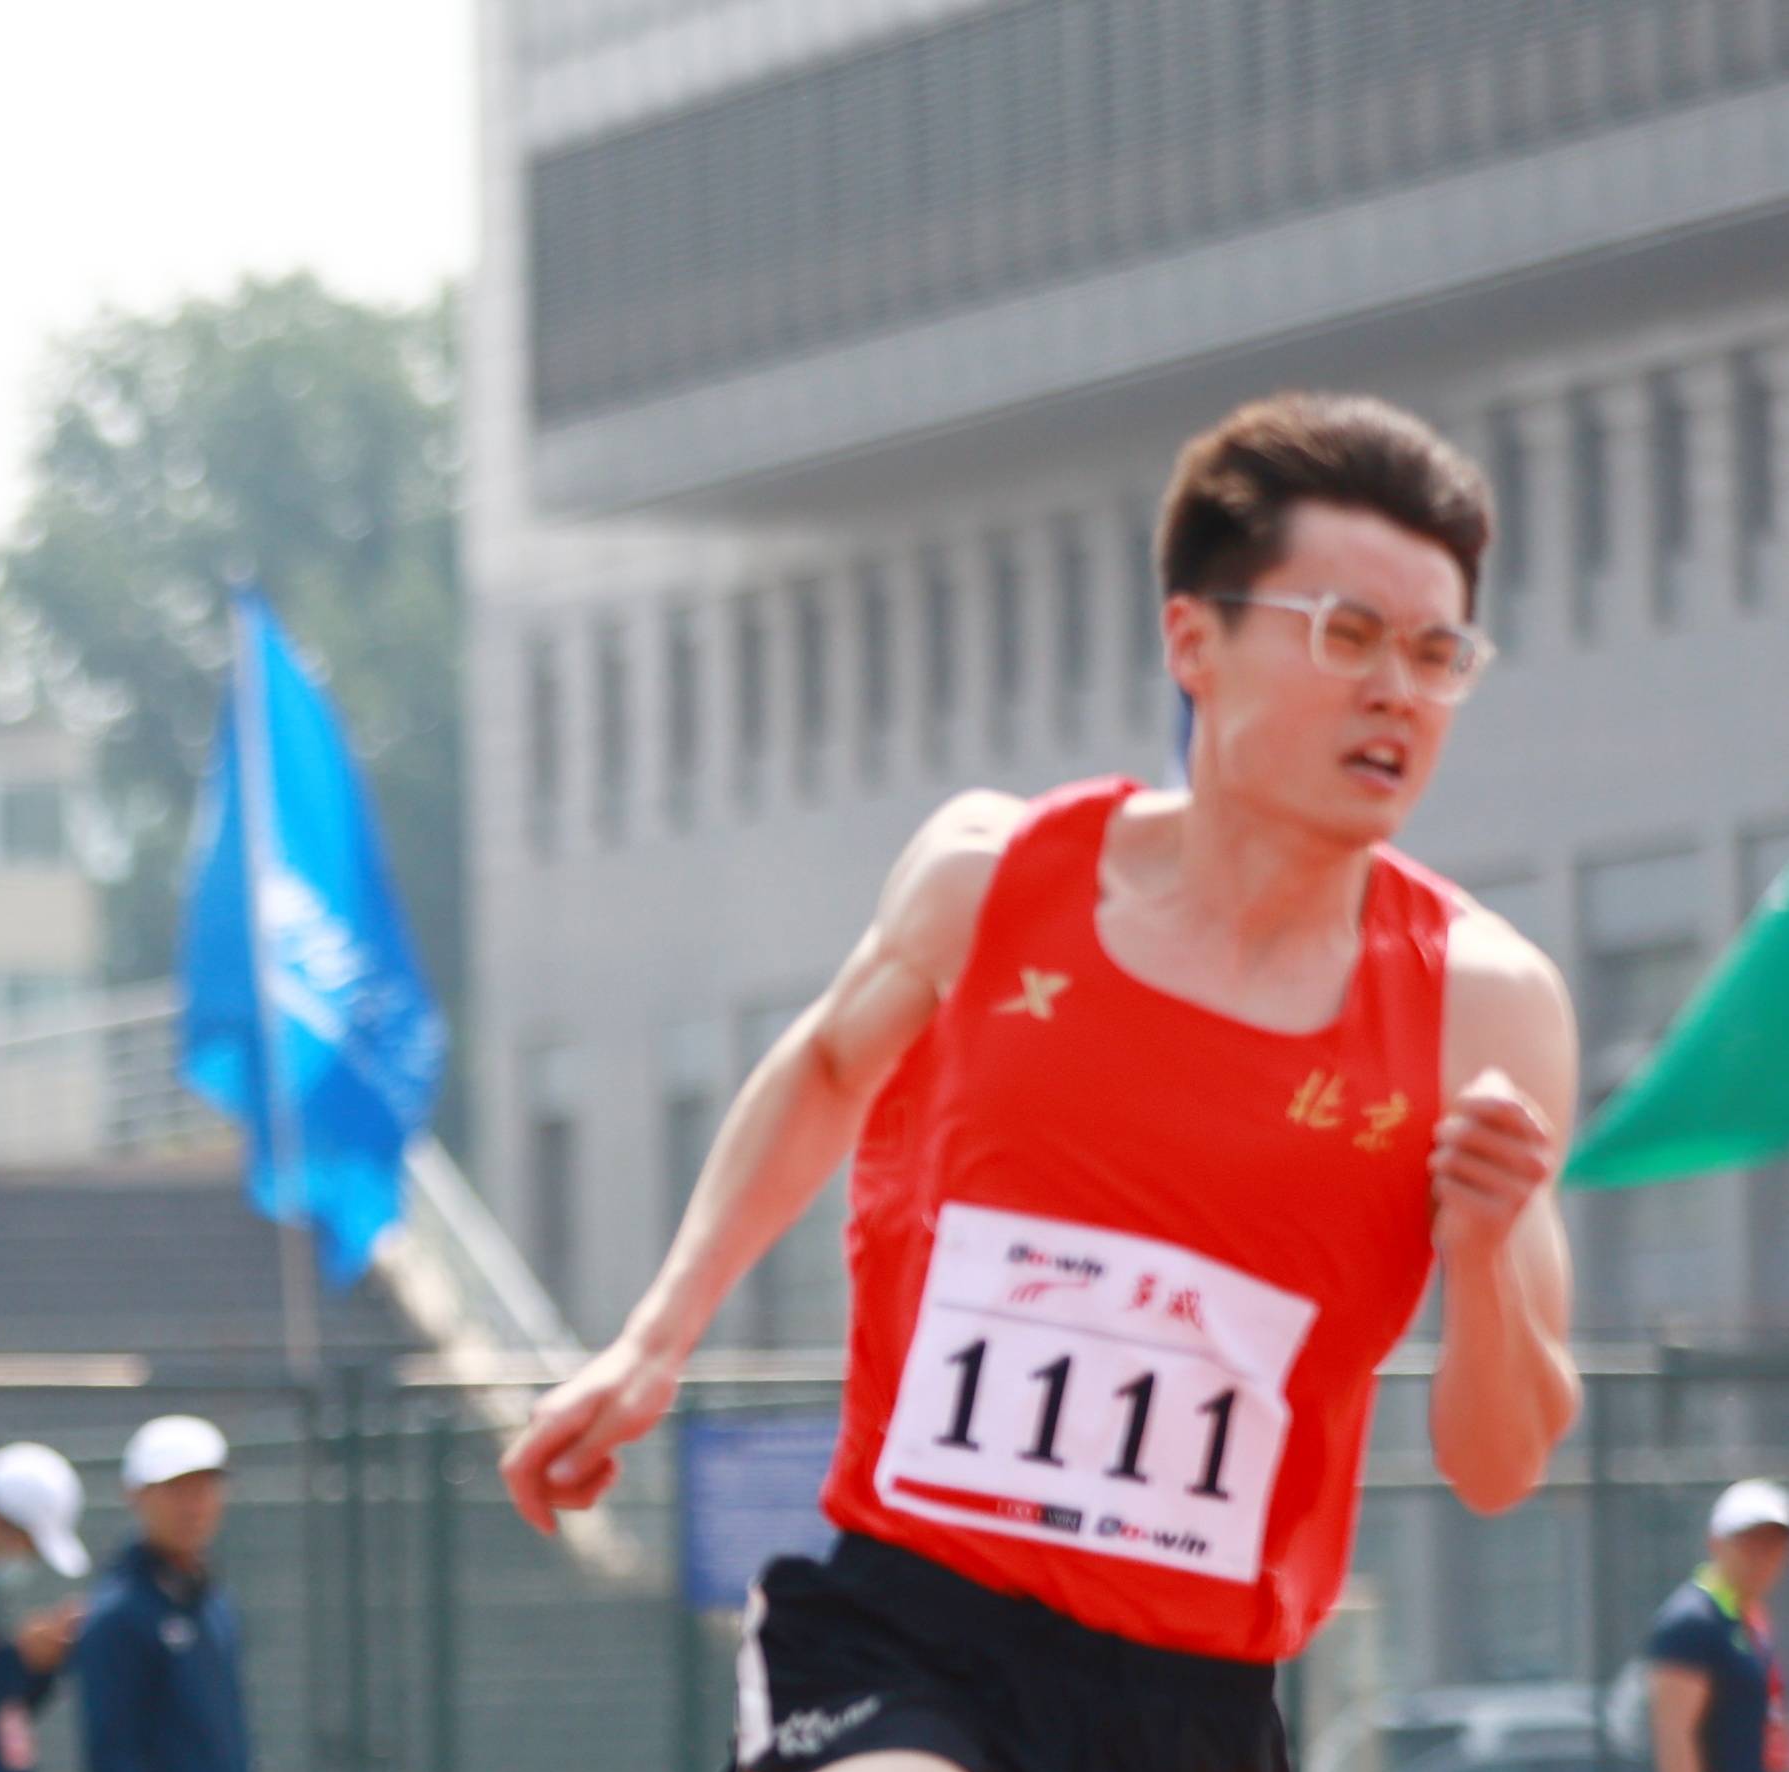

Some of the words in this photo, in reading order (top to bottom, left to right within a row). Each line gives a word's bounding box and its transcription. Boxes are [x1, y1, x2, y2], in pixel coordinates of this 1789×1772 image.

[1006, 1243, 1104, 1278] Do-win
[932, 1336, 1240, 1502] 1111
[1095, 1514, 1208, 1557] Do-win
